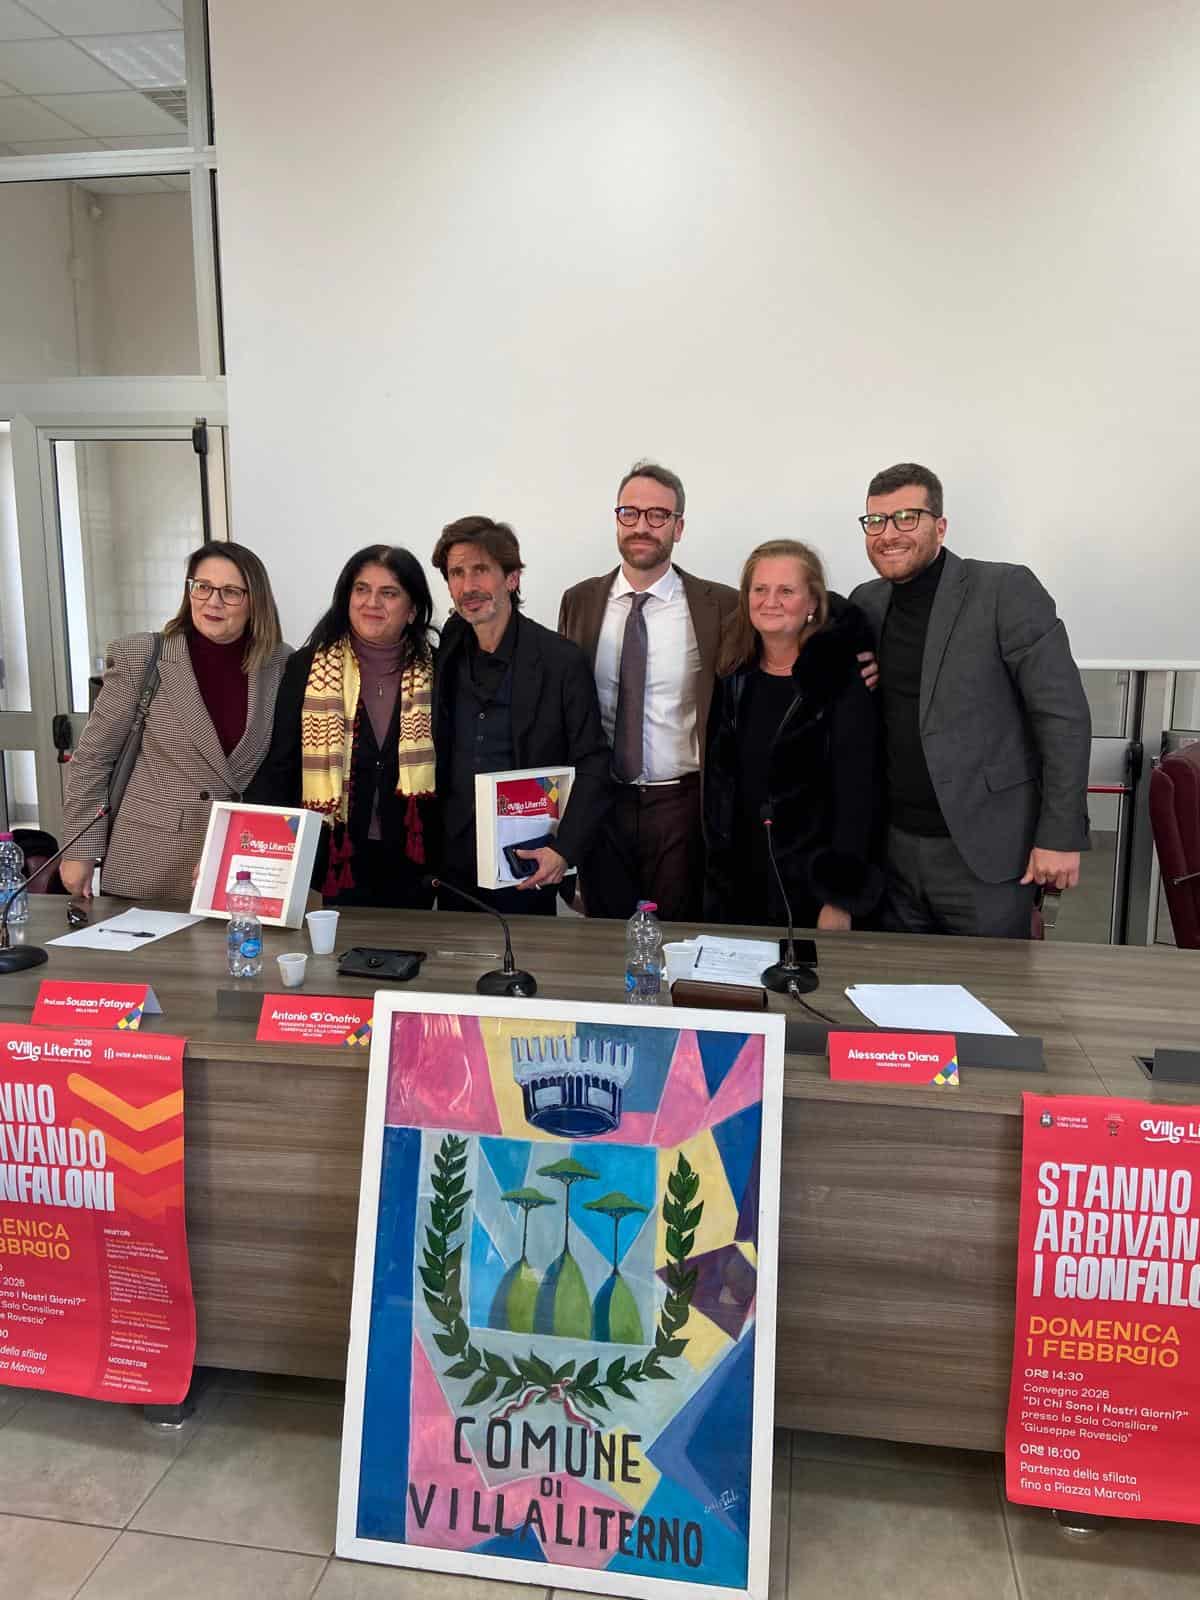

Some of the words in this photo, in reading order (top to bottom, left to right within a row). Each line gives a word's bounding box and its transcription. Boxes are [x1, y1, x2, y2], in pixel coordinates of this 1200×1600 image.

[66, 996, 98, 1007] Souzan
[99, 998, 135, 1010] Fatayer
[272, 1011, 308, 1021] Antonio
[7, 1040, 42, 1061] Villa
[44, 1042, 92, 1058] Literno
[848, 1048, 906, 1062] Alessandro
[907, 1051, 940, 1063] Diana
[1140, 1119, 1185, 1144] Villa
[1038, 1161, 1192, 1215] STANNO
[0, 1217, 70, 1241] ENICA
[1033, 1208, 1200, 1261] ARRIVAN
[3, 1276, 25, 1288] 2026
[1033, 1254, 1044, 1297] I
[22, 1291, 48, 1302] Nostri
[1, 1300, 20, 1310] Sala
[22, 1303, 65, 1317] Consiliare
[1029, 1315, 1181, 1346] DOMENICA
[0, 1344, 20, 1357] della
[21, 1347, 48, 1361] sfilata
[1026, 1337, 1034, 1358] 1
[10, 1360, 46, 1376] Marconi
[1052, 1369, 1084, 1382] 14:30
[1023, 1383, 1079, 1399] Convegno
[1081, 1389, 1110, 1400] 2026
[1043, 1398, 1063, 1409] Chi
[1065, 1401, 1094, 1412] Sono
[1103, 1404, 1138, 1416] Nostri
[1021, 1410, 1059, 1422] presso
[1061, 1413, 1071, 1423] la
[1074, 1415, 1099, 1426] Sala
[1102, 1417, 1159, 1432] Consiliare
[453, 1416, 642, 1484] COMUNE
[1047, 1446, 1081, 1461] 16:00
[1020, 1461, 1070, 1478] Partenza
[1073, 1468, 1100, 1482] della
[1102, 1471, 1137, 1486] sfilata
[539, 1476, 563, 1498] DI
[1020, 1477, 1042, 1490] fino
[1044, 1483, 1052, 1492] a
[1054, 1481, 1091, 1497] Piazza
[1094, 1487, 1142, 1503] Marconi
